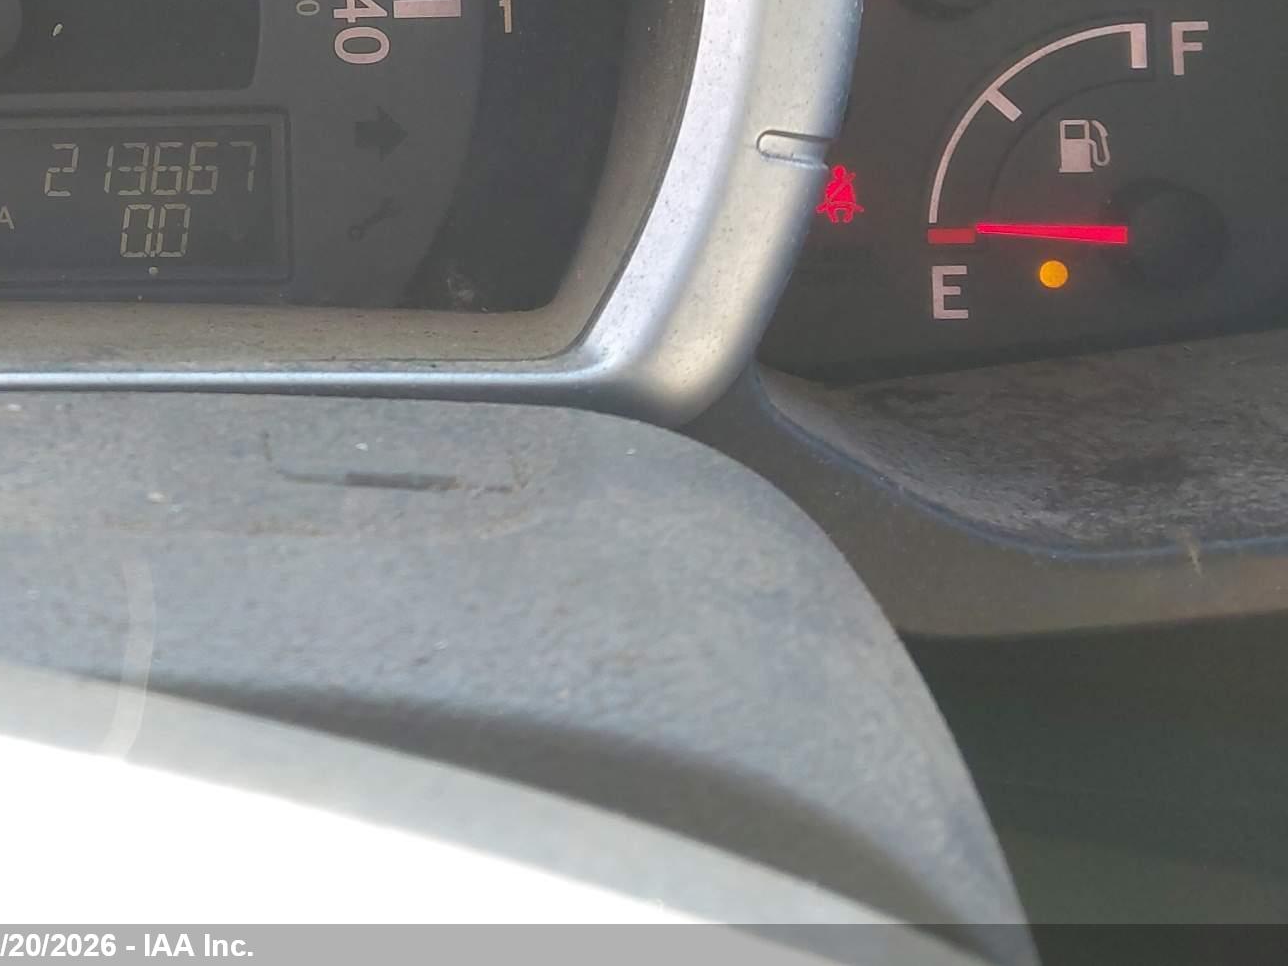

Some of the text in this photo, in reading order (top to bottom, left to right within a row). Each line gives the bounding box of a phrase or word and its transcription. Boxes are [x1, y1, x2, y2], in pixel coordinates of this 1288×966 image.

[1171, 21, 1209, 76] F
[44, 141, 257, 197] 213667
[932, 265, 969, 320] E
